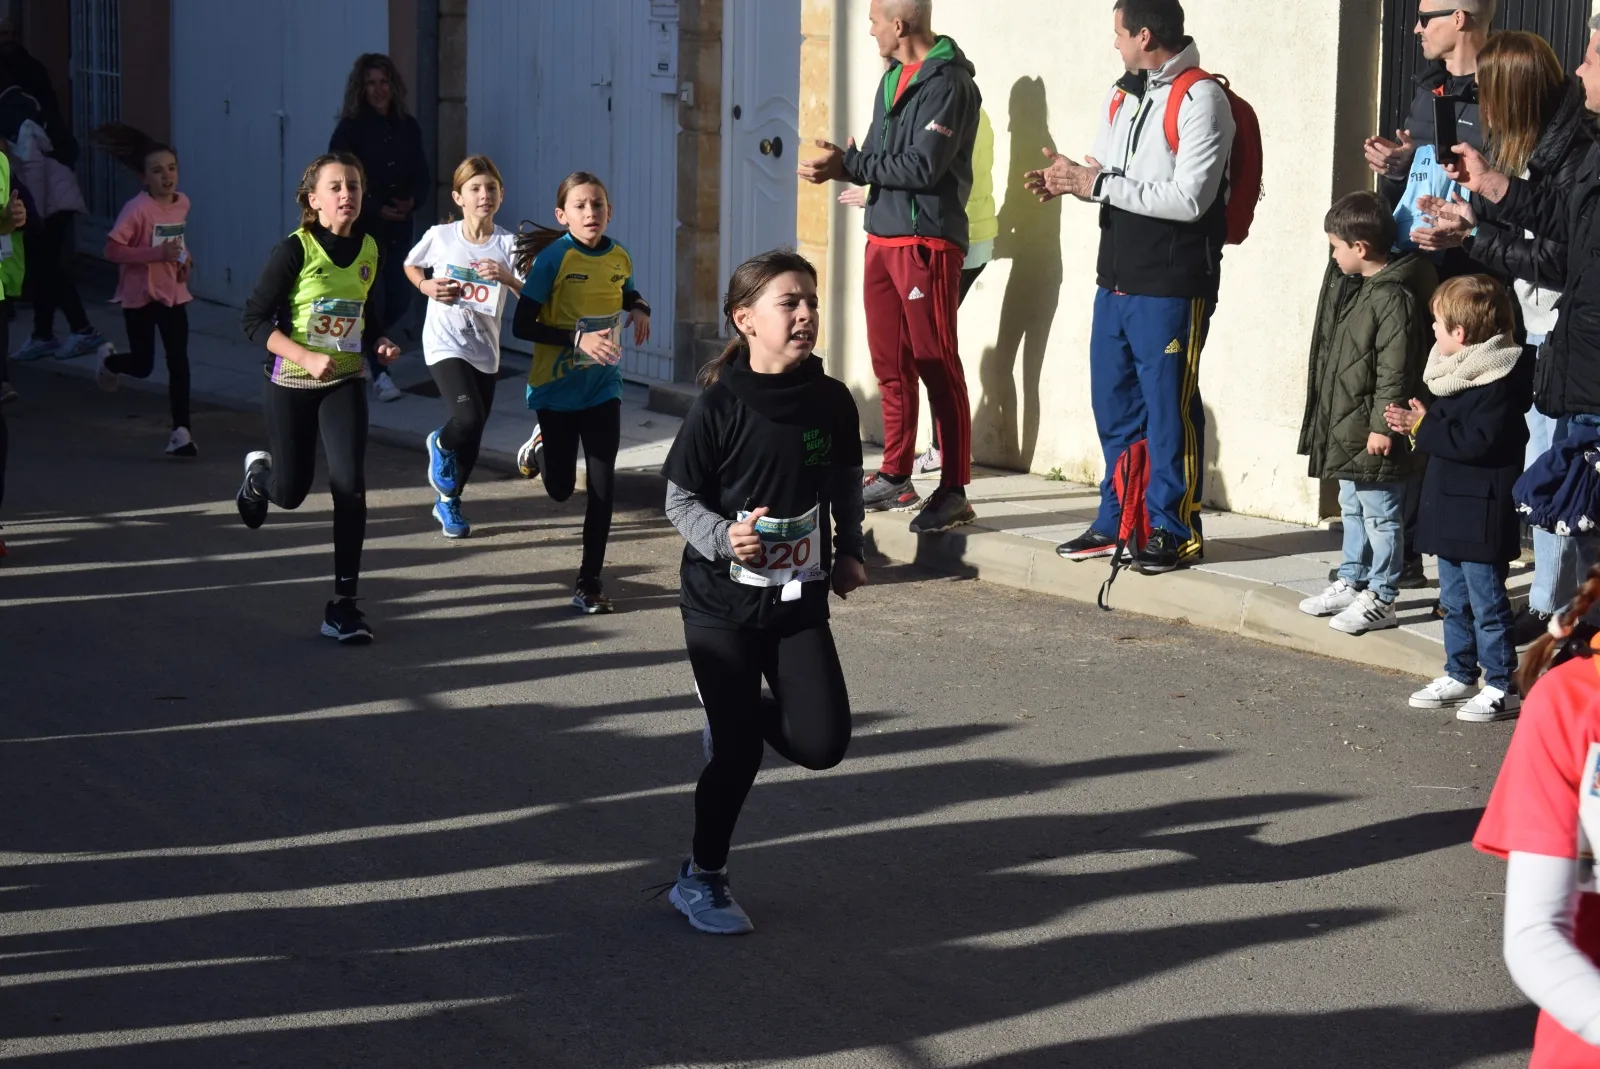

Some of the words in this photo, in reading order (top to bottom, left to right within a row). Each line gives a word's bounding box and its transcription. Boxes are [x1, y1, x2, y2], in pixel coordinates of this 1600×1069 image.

[314, 315, 357, 339] 357
[803, 429, 819, 441] BEEP
[746, 537, 811, 570] 320
